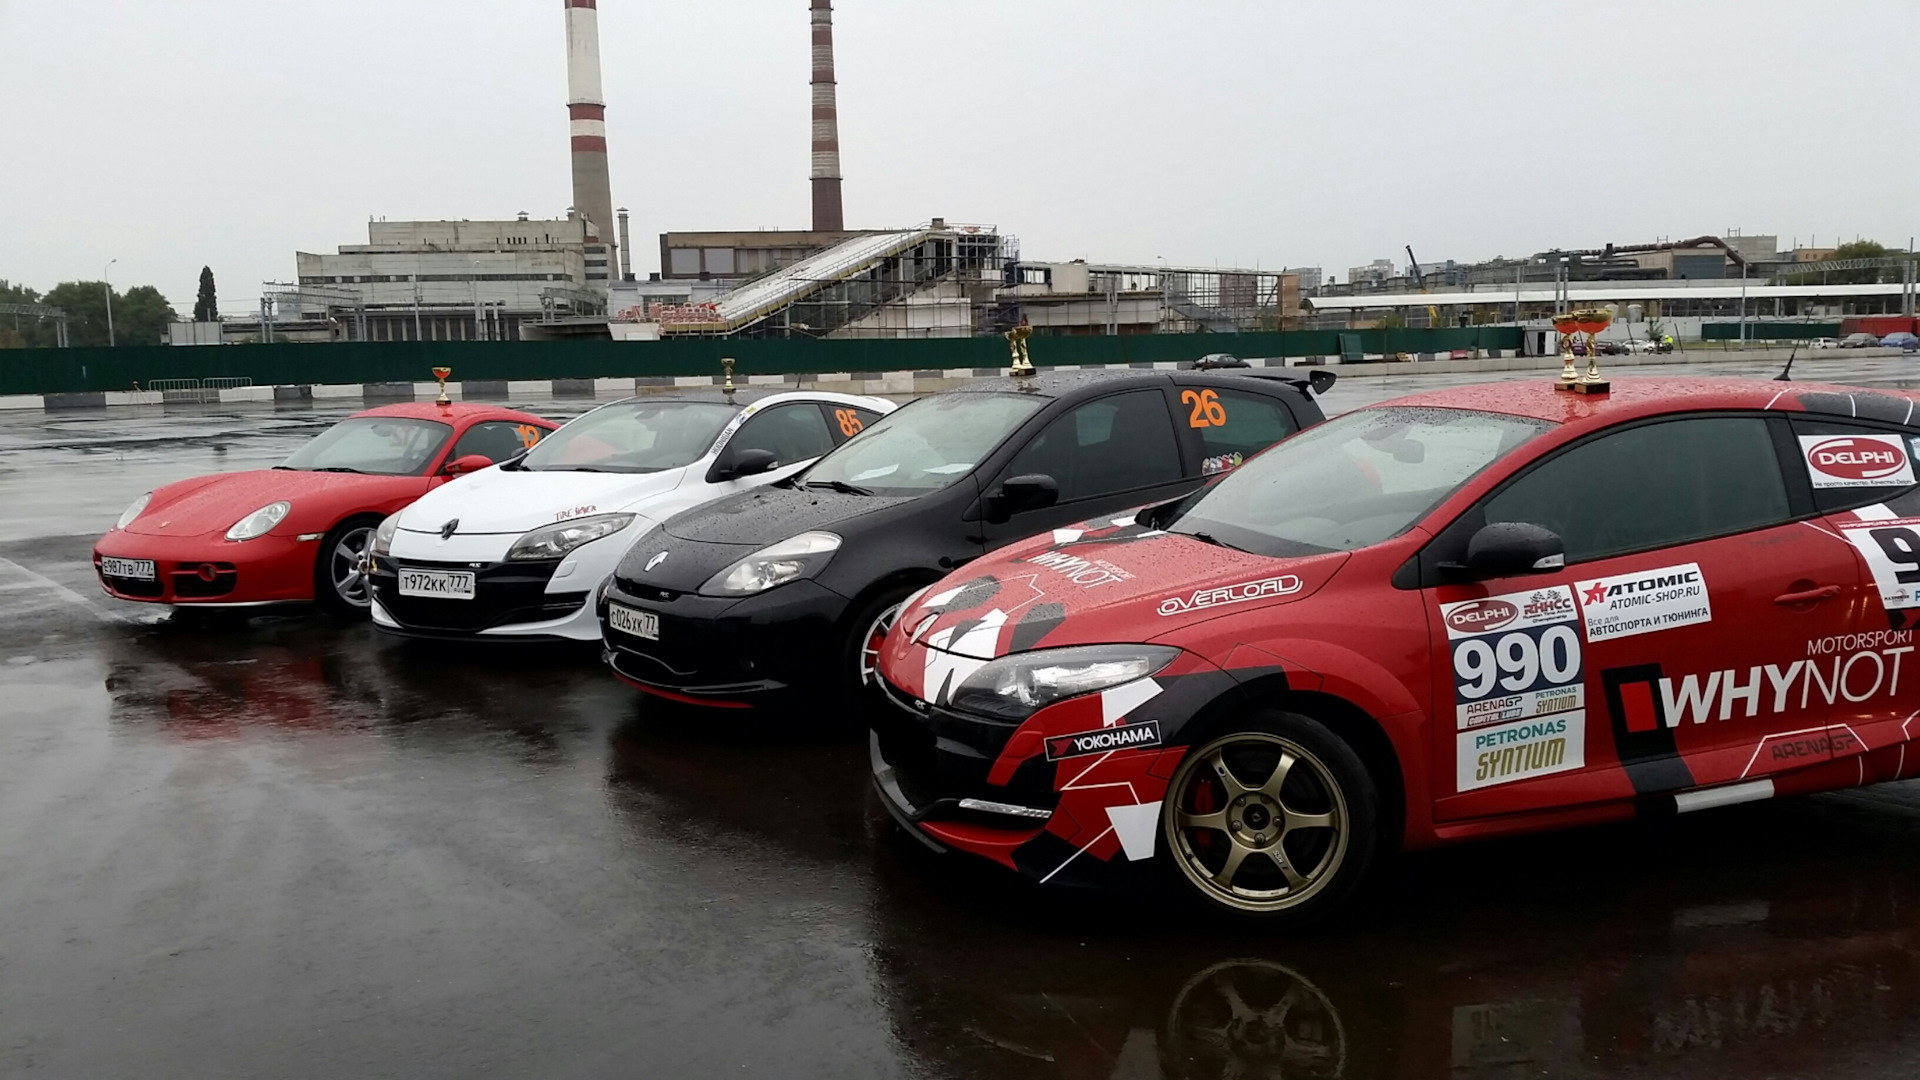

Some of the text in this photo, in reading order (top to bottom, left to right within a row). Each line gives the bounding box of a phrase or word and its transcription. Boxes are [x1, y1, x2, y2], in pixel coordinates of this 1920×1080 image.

[1181, 389, 1226, 428] 26
[835, 409, 863, 437] 85
[1818, 451, 1896, 465] DELPHI
[135, 561, 151, 572] 777
[1027, 550, 1124, 588] WHYNOT
[449, 575, 468, 588] 777
[1606, 571, 1699, 597] ATOMIC
[1157, 574, 1303, 616] OVERLOAD
[1609, 585, 1700, 611] ATOMIC-SHOP.RU
[645, 615, 655, 631] 77
[1453, 606, 1510, 625] DELPHI
[1587, 618, 1603, 627] Все
[1589, 607, 1709, 637] АВТОСПОРТА И ТЮНИНГА
[1807, 629, 1914, 655] MOTORSPORT
[1453, 625, 1581, 699] 990
[1535, 686, 1577, 699] PETRONAS
[1658, 646, 1915, 728] WHYNOT
[1467, 696, 1523, 715] ARENAGP
[1535, 695, 1577, 714] SYNTIUM
[1074, 727, 1155, 751] YOKOHAMA
[1475, 719, 1567, 749] PETRONAS
[1475, 737, 1567, 781] SYNTIUM
